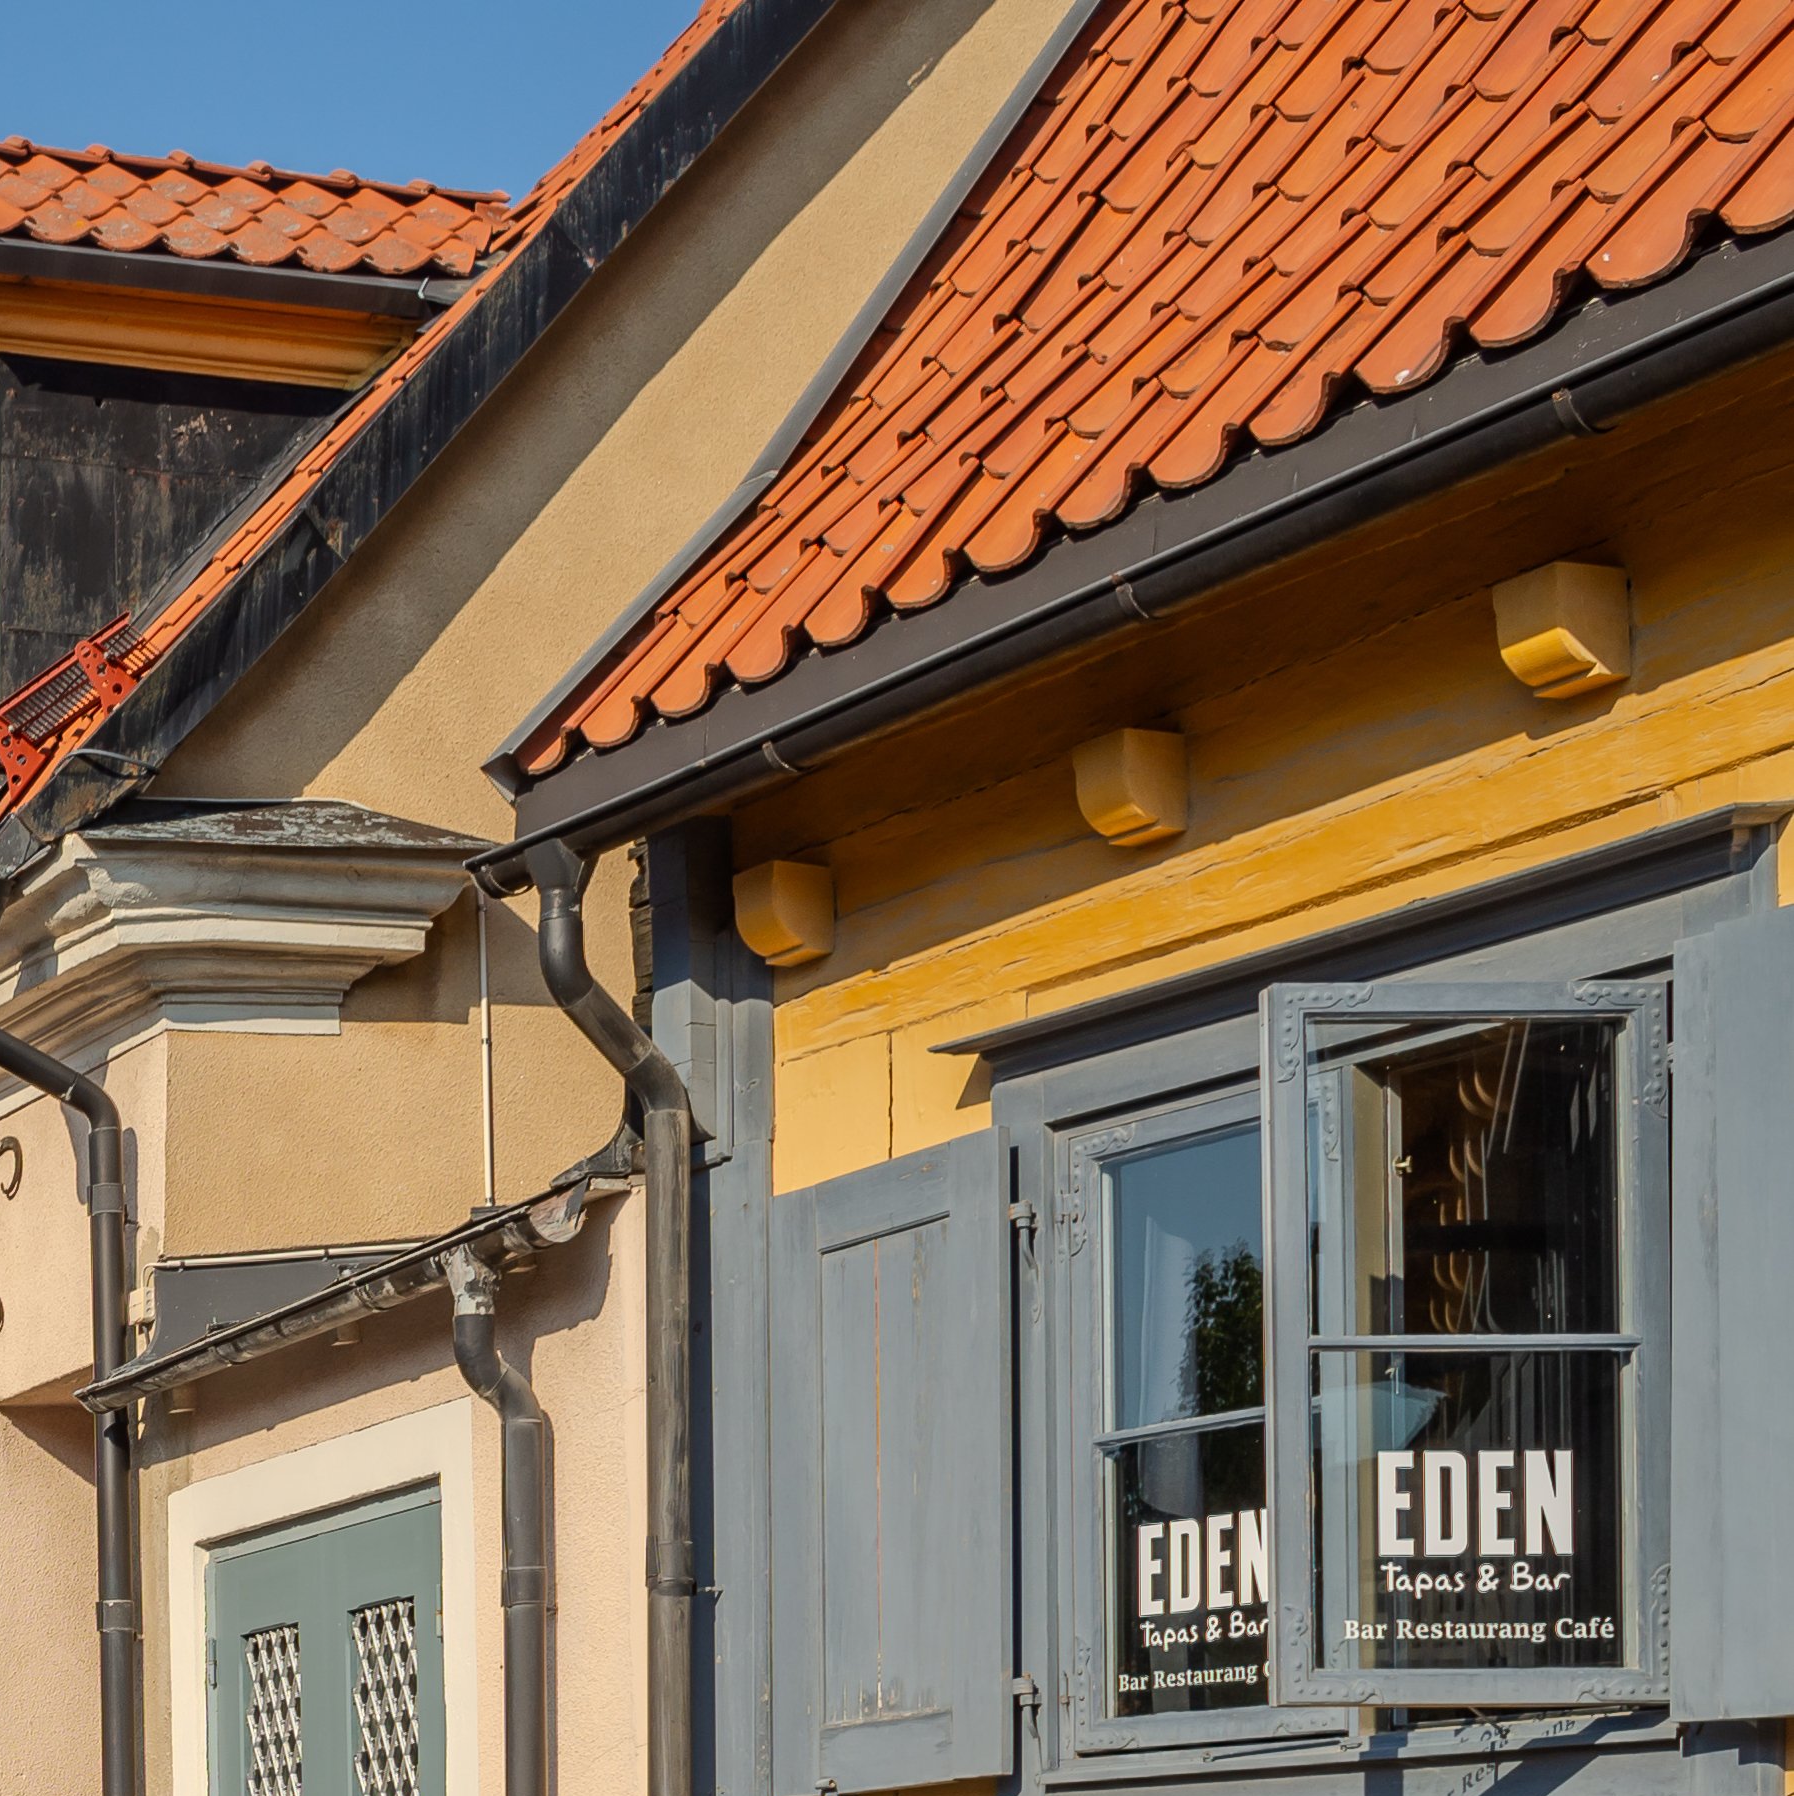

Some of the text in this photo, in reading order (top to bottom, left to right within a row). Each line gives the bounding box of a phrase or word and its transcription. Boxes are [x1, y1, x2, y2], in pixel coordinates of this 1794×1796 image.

[1377, 1449, 1574, 1556] EDEN
[1138, 1508, 1269, 1617] EDEN
[1476, 1563, 1500, 1593] &
[1509, 1561, 1571, 1592] Bar
[1206, 1614, 1222, 1642] &
[1228, 1610, 1269, 1639] Bar
[1344, 1616, 1615, 1643] Bar Restaurang Café
[1118, 1674, 1149, 1692] Bar
[1153, 1664, 1259, 1690] Restaurang
